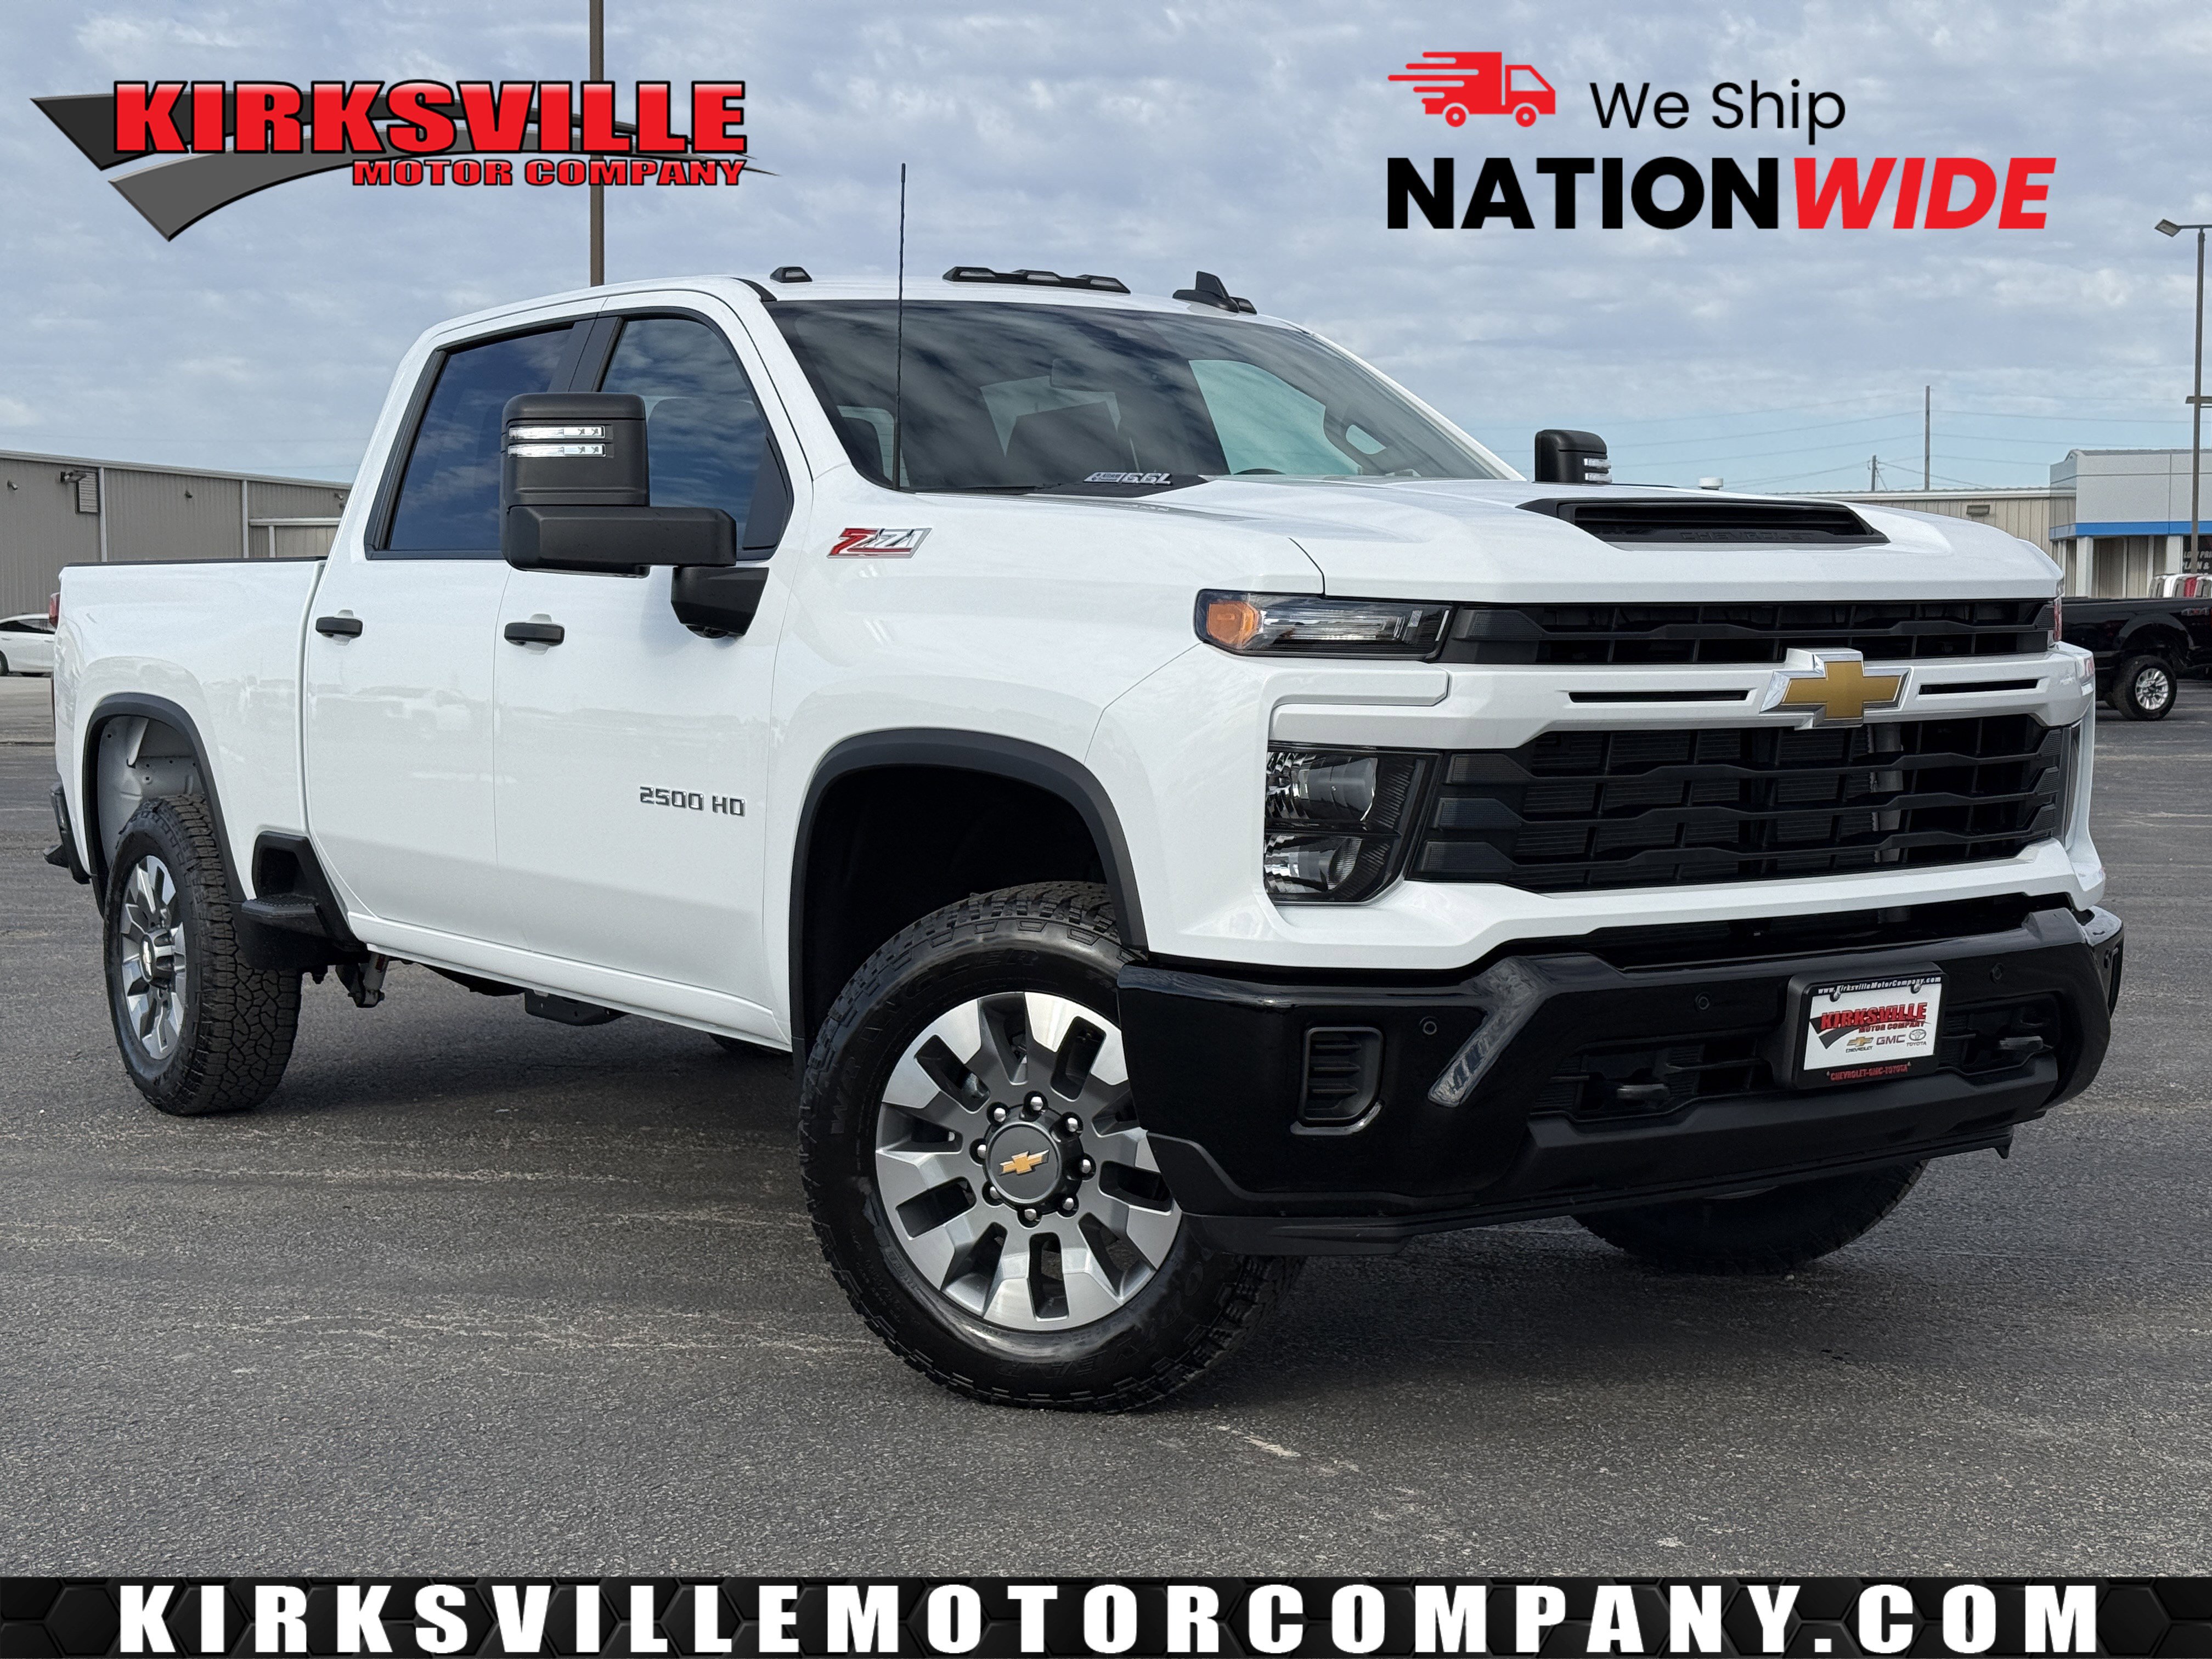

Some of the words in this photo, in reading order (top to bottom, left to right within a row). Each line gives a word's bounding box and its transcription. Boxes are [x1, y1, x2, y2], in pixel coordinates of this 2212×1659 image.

[827, 527, 932, 558] Z71
[640, 786, 704, 811] 2500
[1820, 1002, 1928, 1030] KIRKSVILLE
[1858, 1024, 1886, 1034] MOTOR
[1887, 1020, 1925, 1030] COMPANY
[1876, 1034, 1906, 1046] GMC
